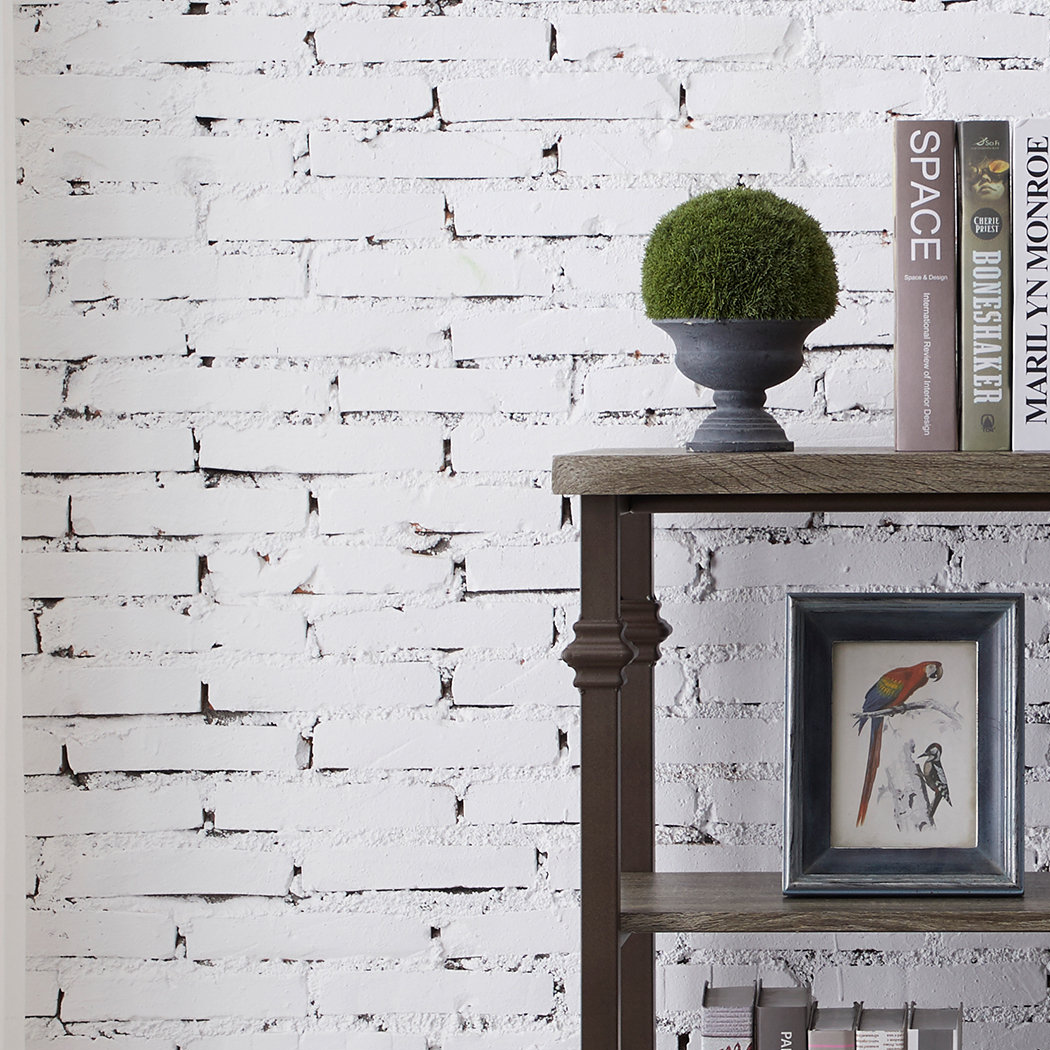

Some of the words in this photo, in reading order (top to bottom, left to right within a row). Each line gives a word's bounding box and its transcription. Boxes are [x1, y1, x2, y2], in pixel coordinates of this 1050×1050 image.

[910, 130, 942, 261] SPACE
[1026, 136, 1049, 271] MONROE
[974, 216, 1000, 225] CHERIE
[975, 225, 1000, 234] PRIEST
[904, 274, 921, 282] Space
[928, 274, 948, 282] Design
[972, 250, 1002, 404] BONESHAKER
[924, 371, 931, 379] of
[923, 380, 931, 407] Interior
[923, 409, 932, 436] Design
